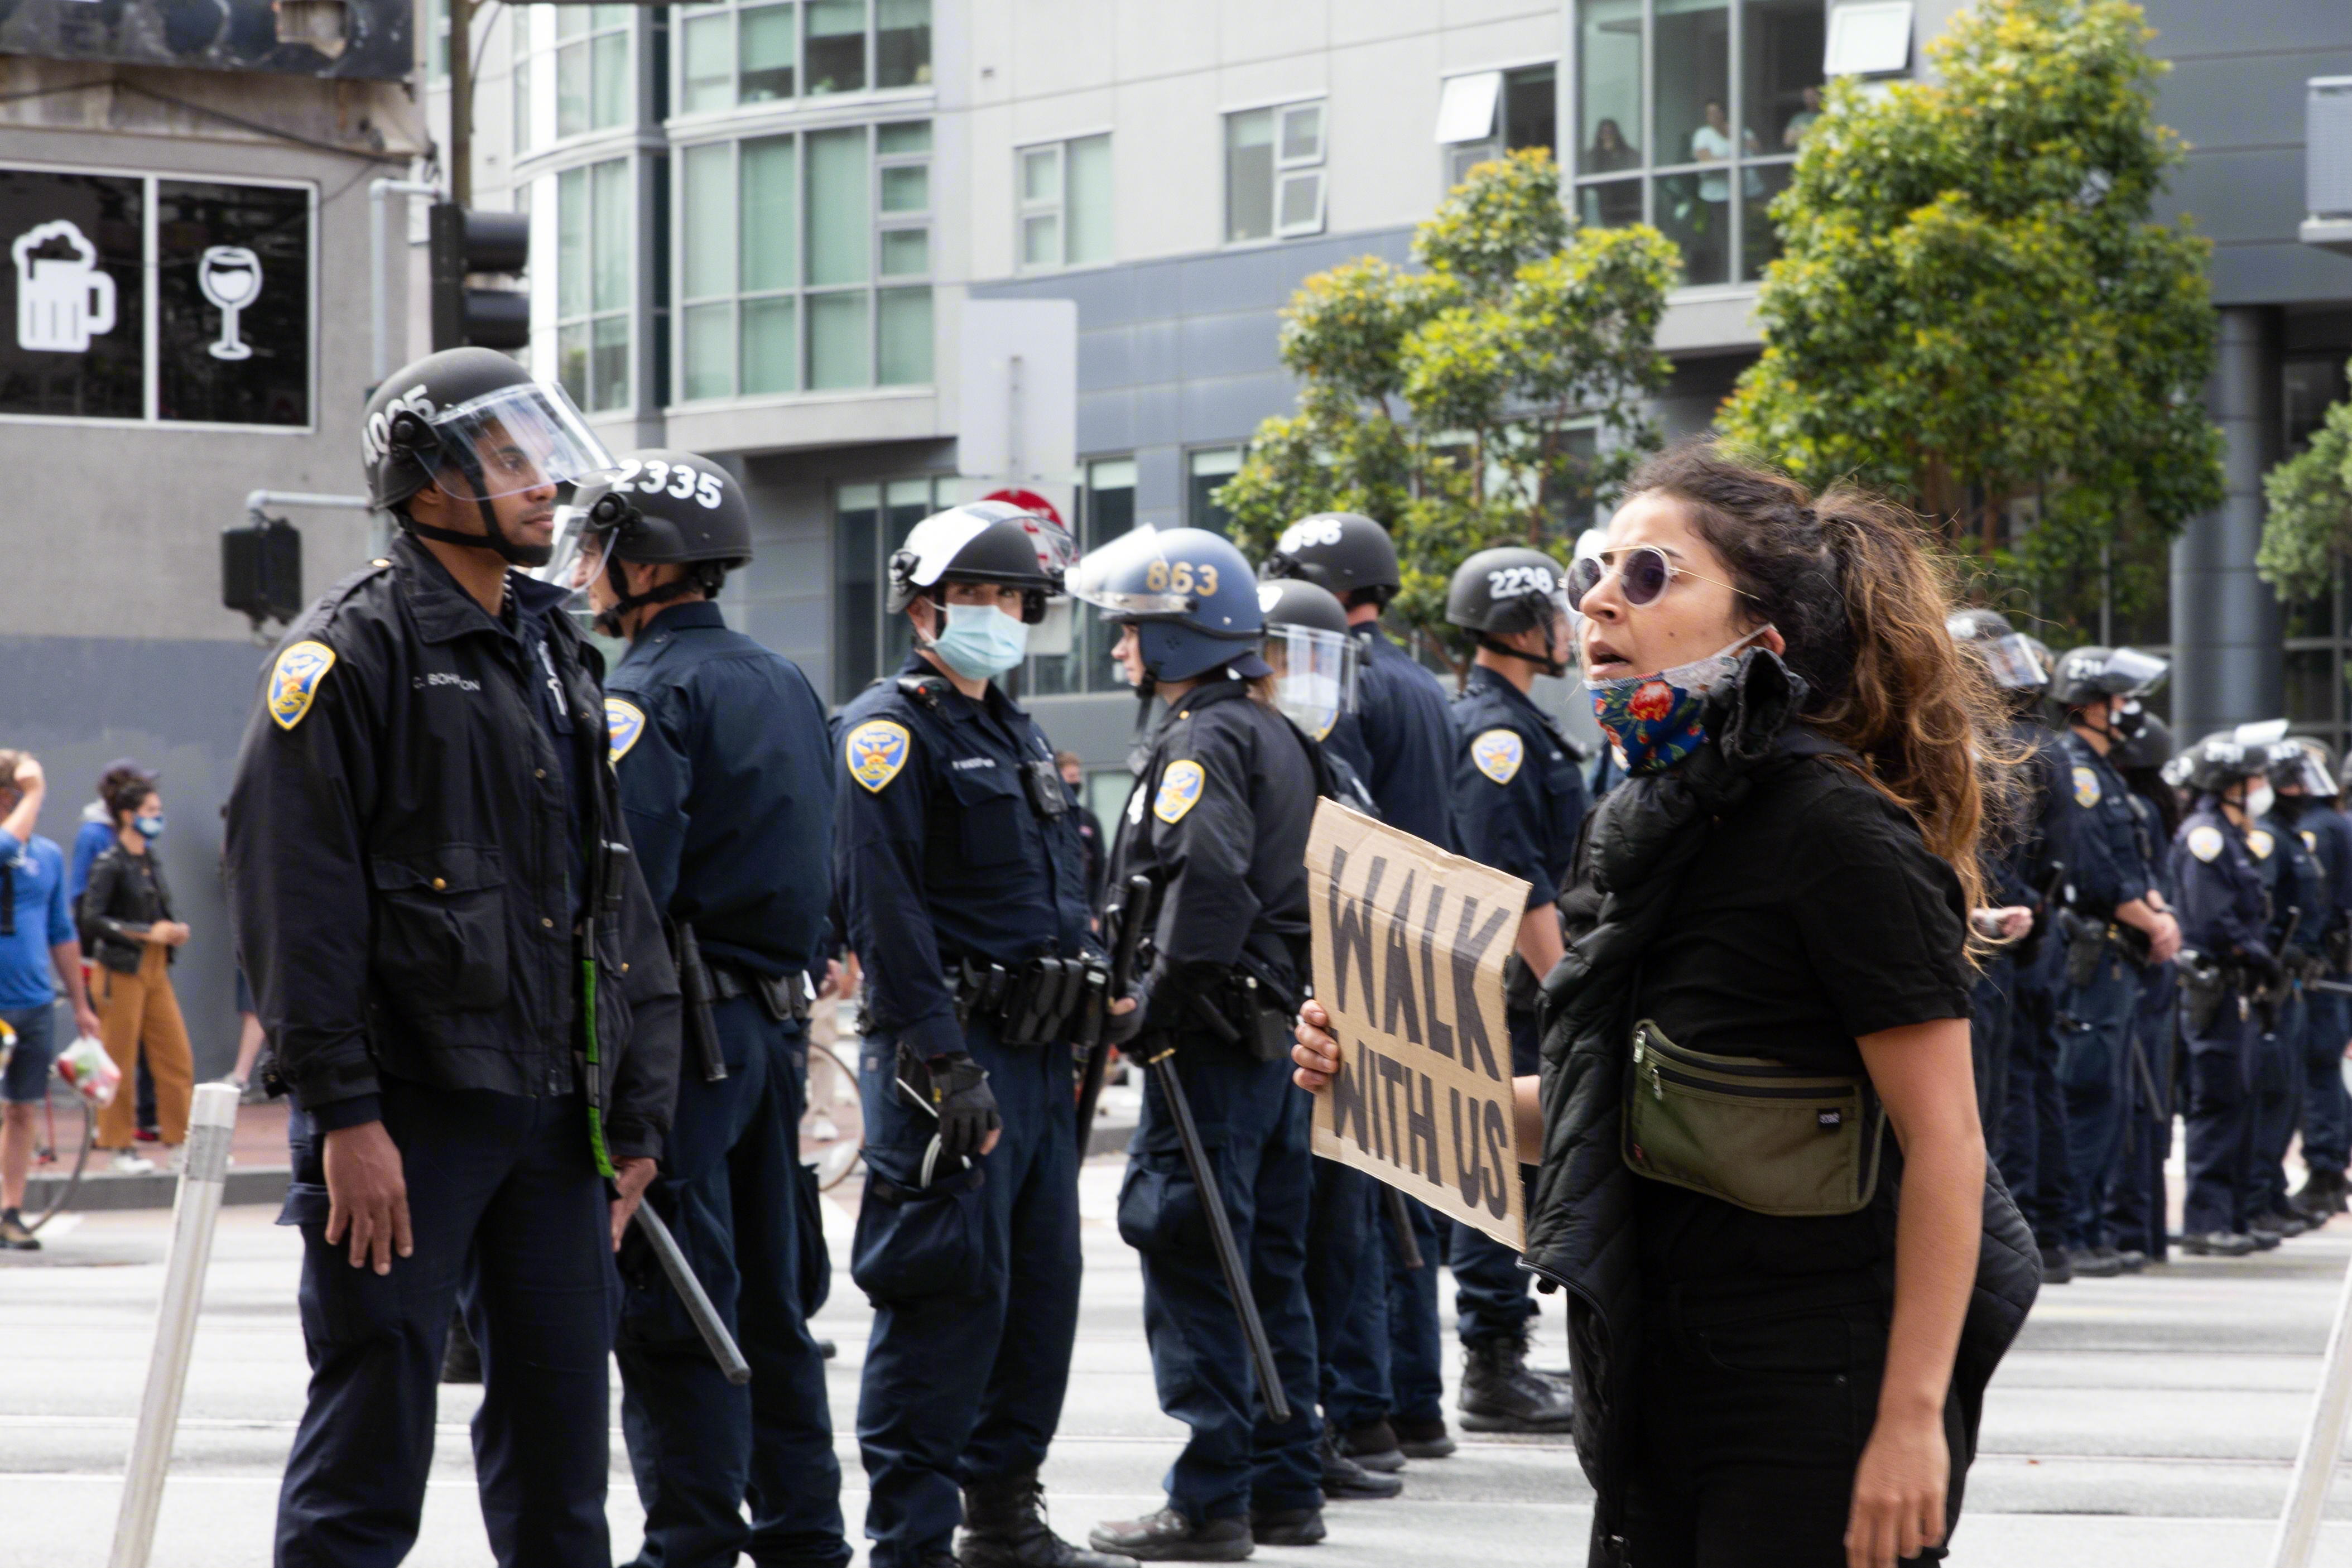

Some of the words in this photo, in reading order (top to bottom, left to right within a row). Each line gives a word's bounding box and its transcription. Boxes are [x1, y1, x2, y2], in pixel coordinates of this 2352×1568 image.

[612, 459, 723, 509] 2335
[1147, 560, 1219, 597] 863
[1328, 845, 1511, 1082] WALK
[1330, 1027, 1443, 1188] WITH
[1449, 1086, 1507, 1221] US
